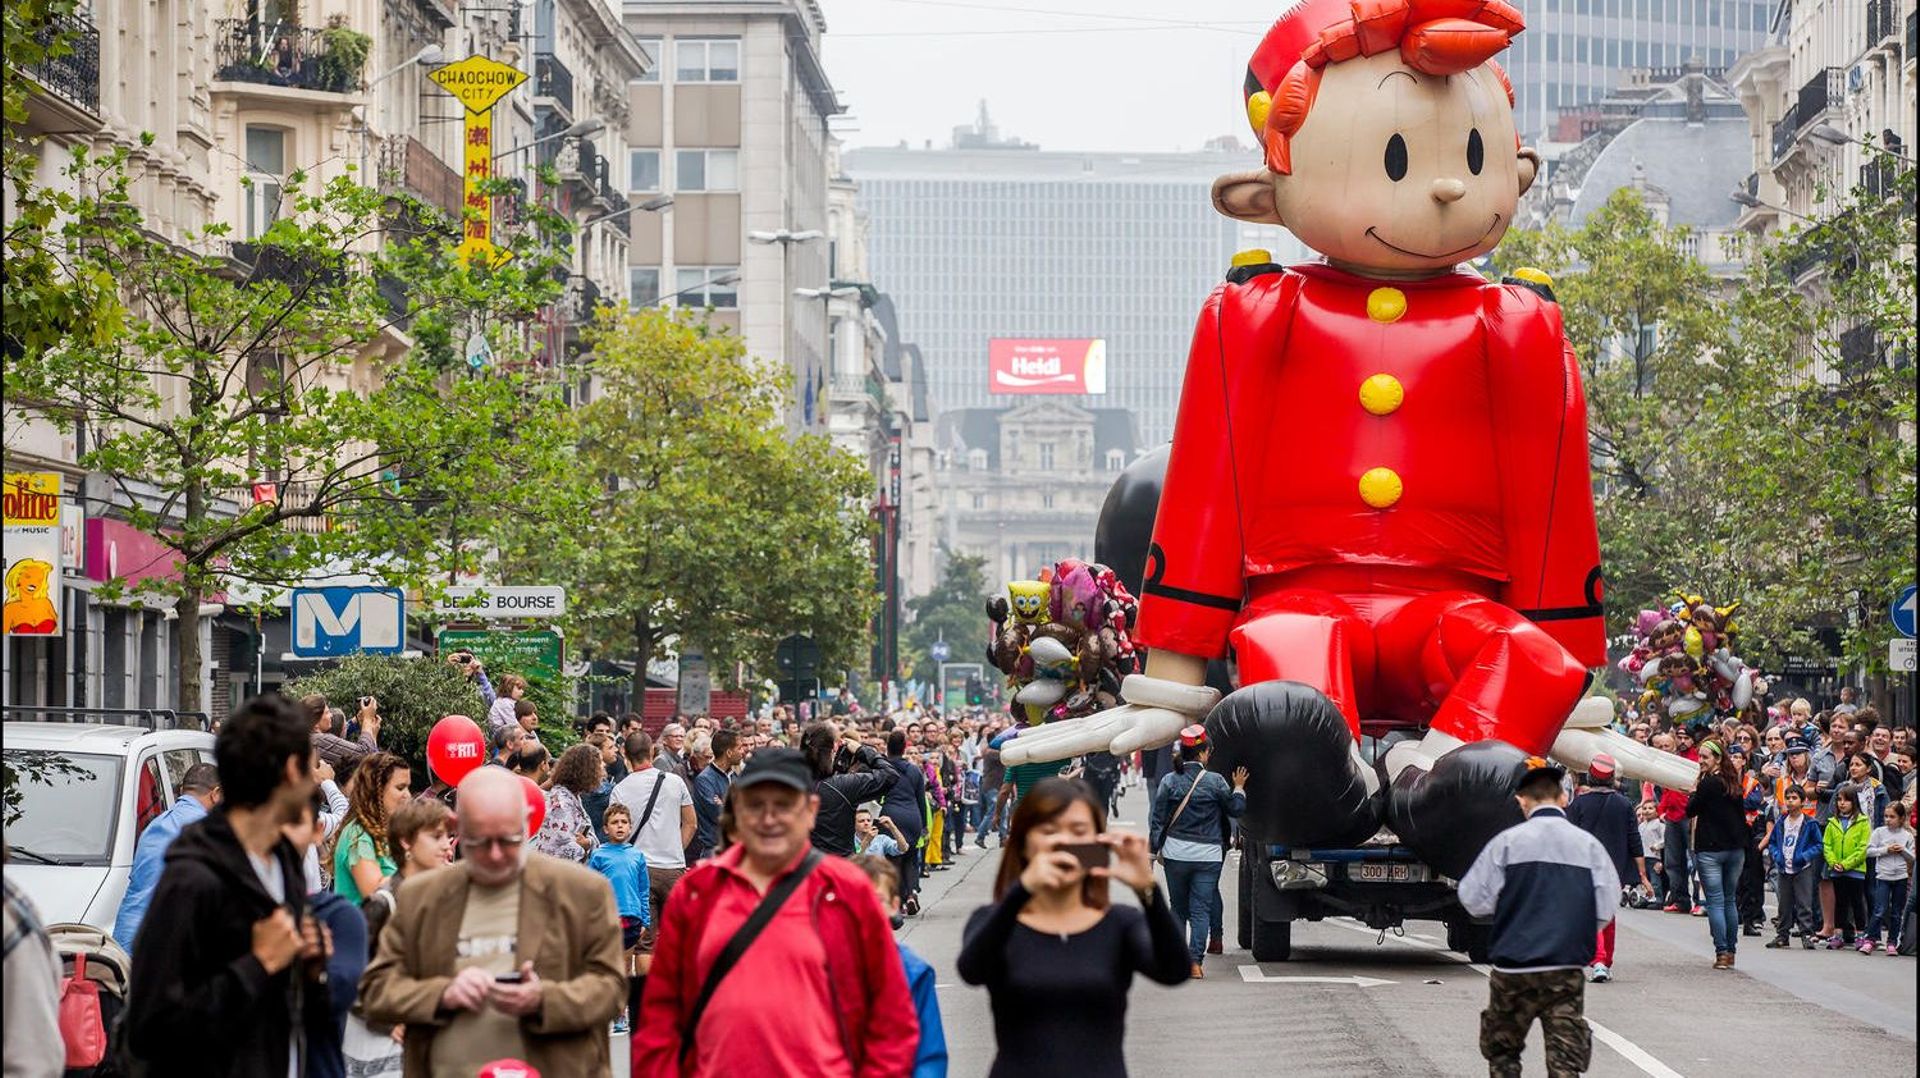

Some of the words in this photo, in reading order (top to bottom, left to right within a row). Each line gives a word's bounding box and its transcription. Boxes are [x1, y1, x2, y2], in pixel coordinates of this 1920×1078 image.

[438, 71, 516, 84] CHAOCHOW
[461, 87, 494, 100] CITY
[1012, 357, 1061, 374] Heidi
[22, 526, 50, 534] MUSIC
[497, 596, 556, 609] BOURSE
[457, 742, 478, 759] RTL
[1363, 866, 1382, 878] 300
